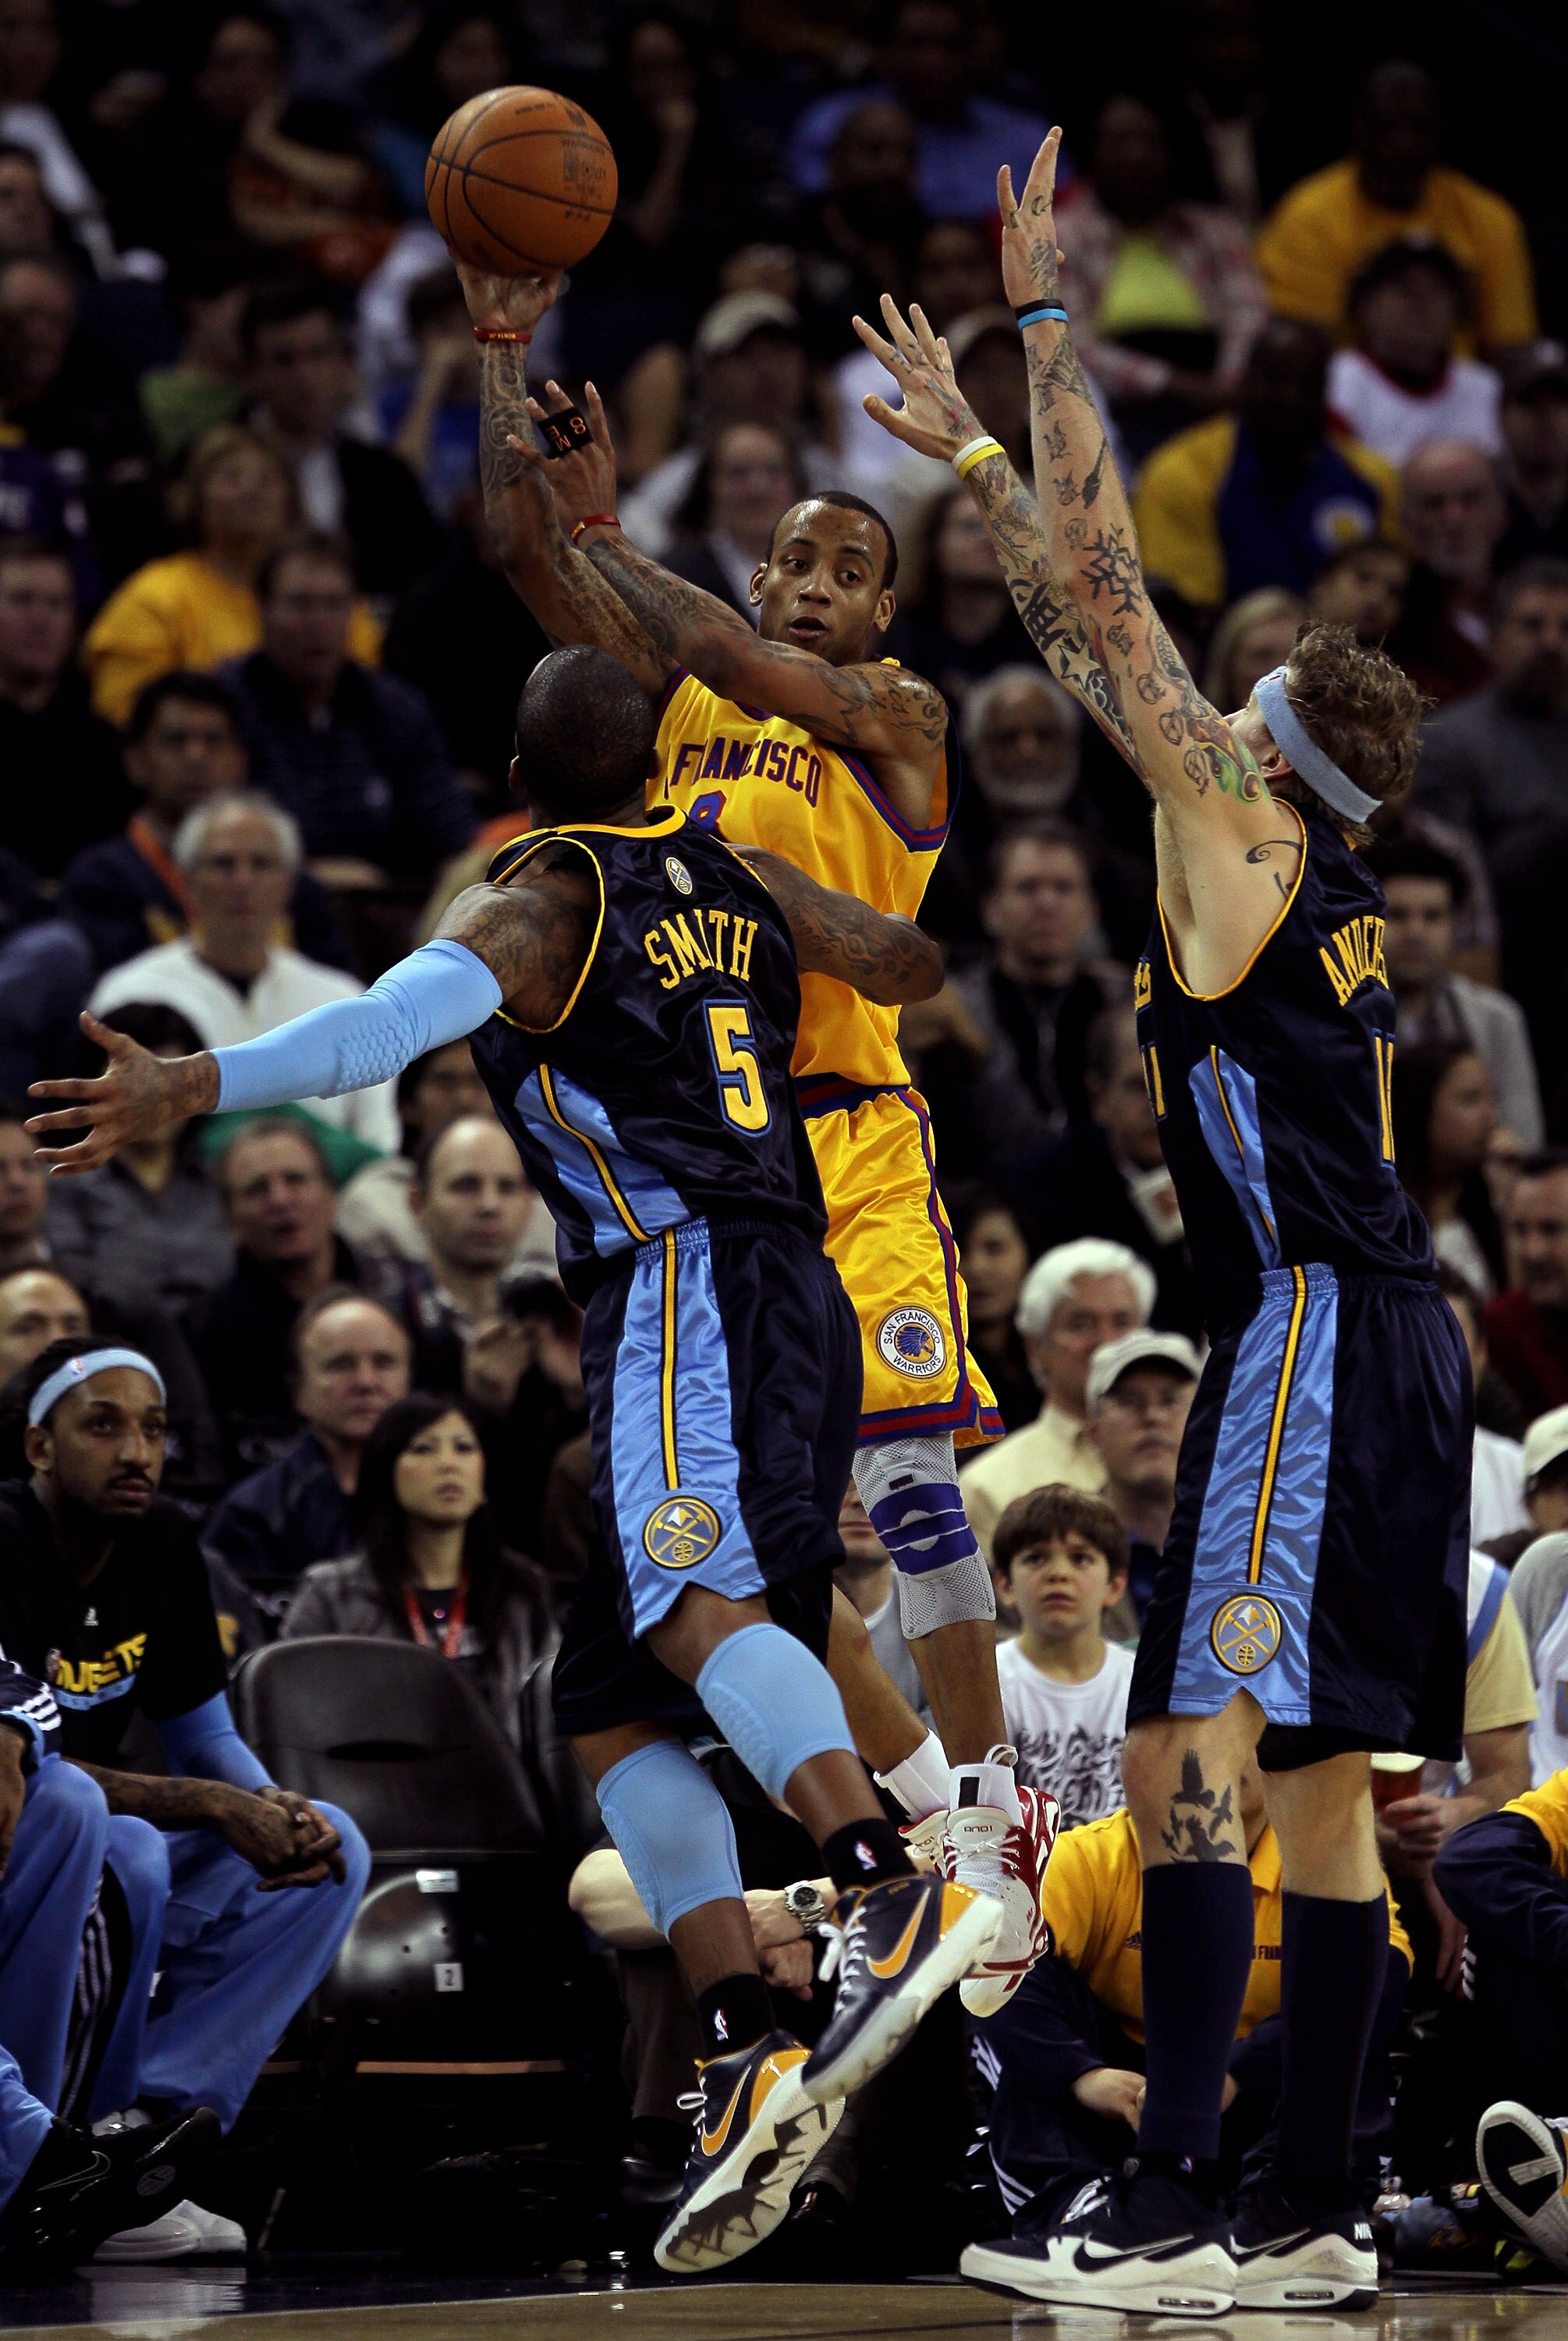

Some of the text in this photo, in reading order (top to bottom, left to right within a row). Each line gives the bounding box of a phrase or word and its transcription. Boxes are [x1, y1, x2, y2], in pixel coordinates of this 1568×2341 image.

[569, 417, 587, 435] 8
[644, 908, 758, 989] SMITH
[703, 999, 772, 1138] 5
[883, 1312, 941, 1345] SAN FRANCISCO
[892, 1355, 941, 1374] WARRIORS
